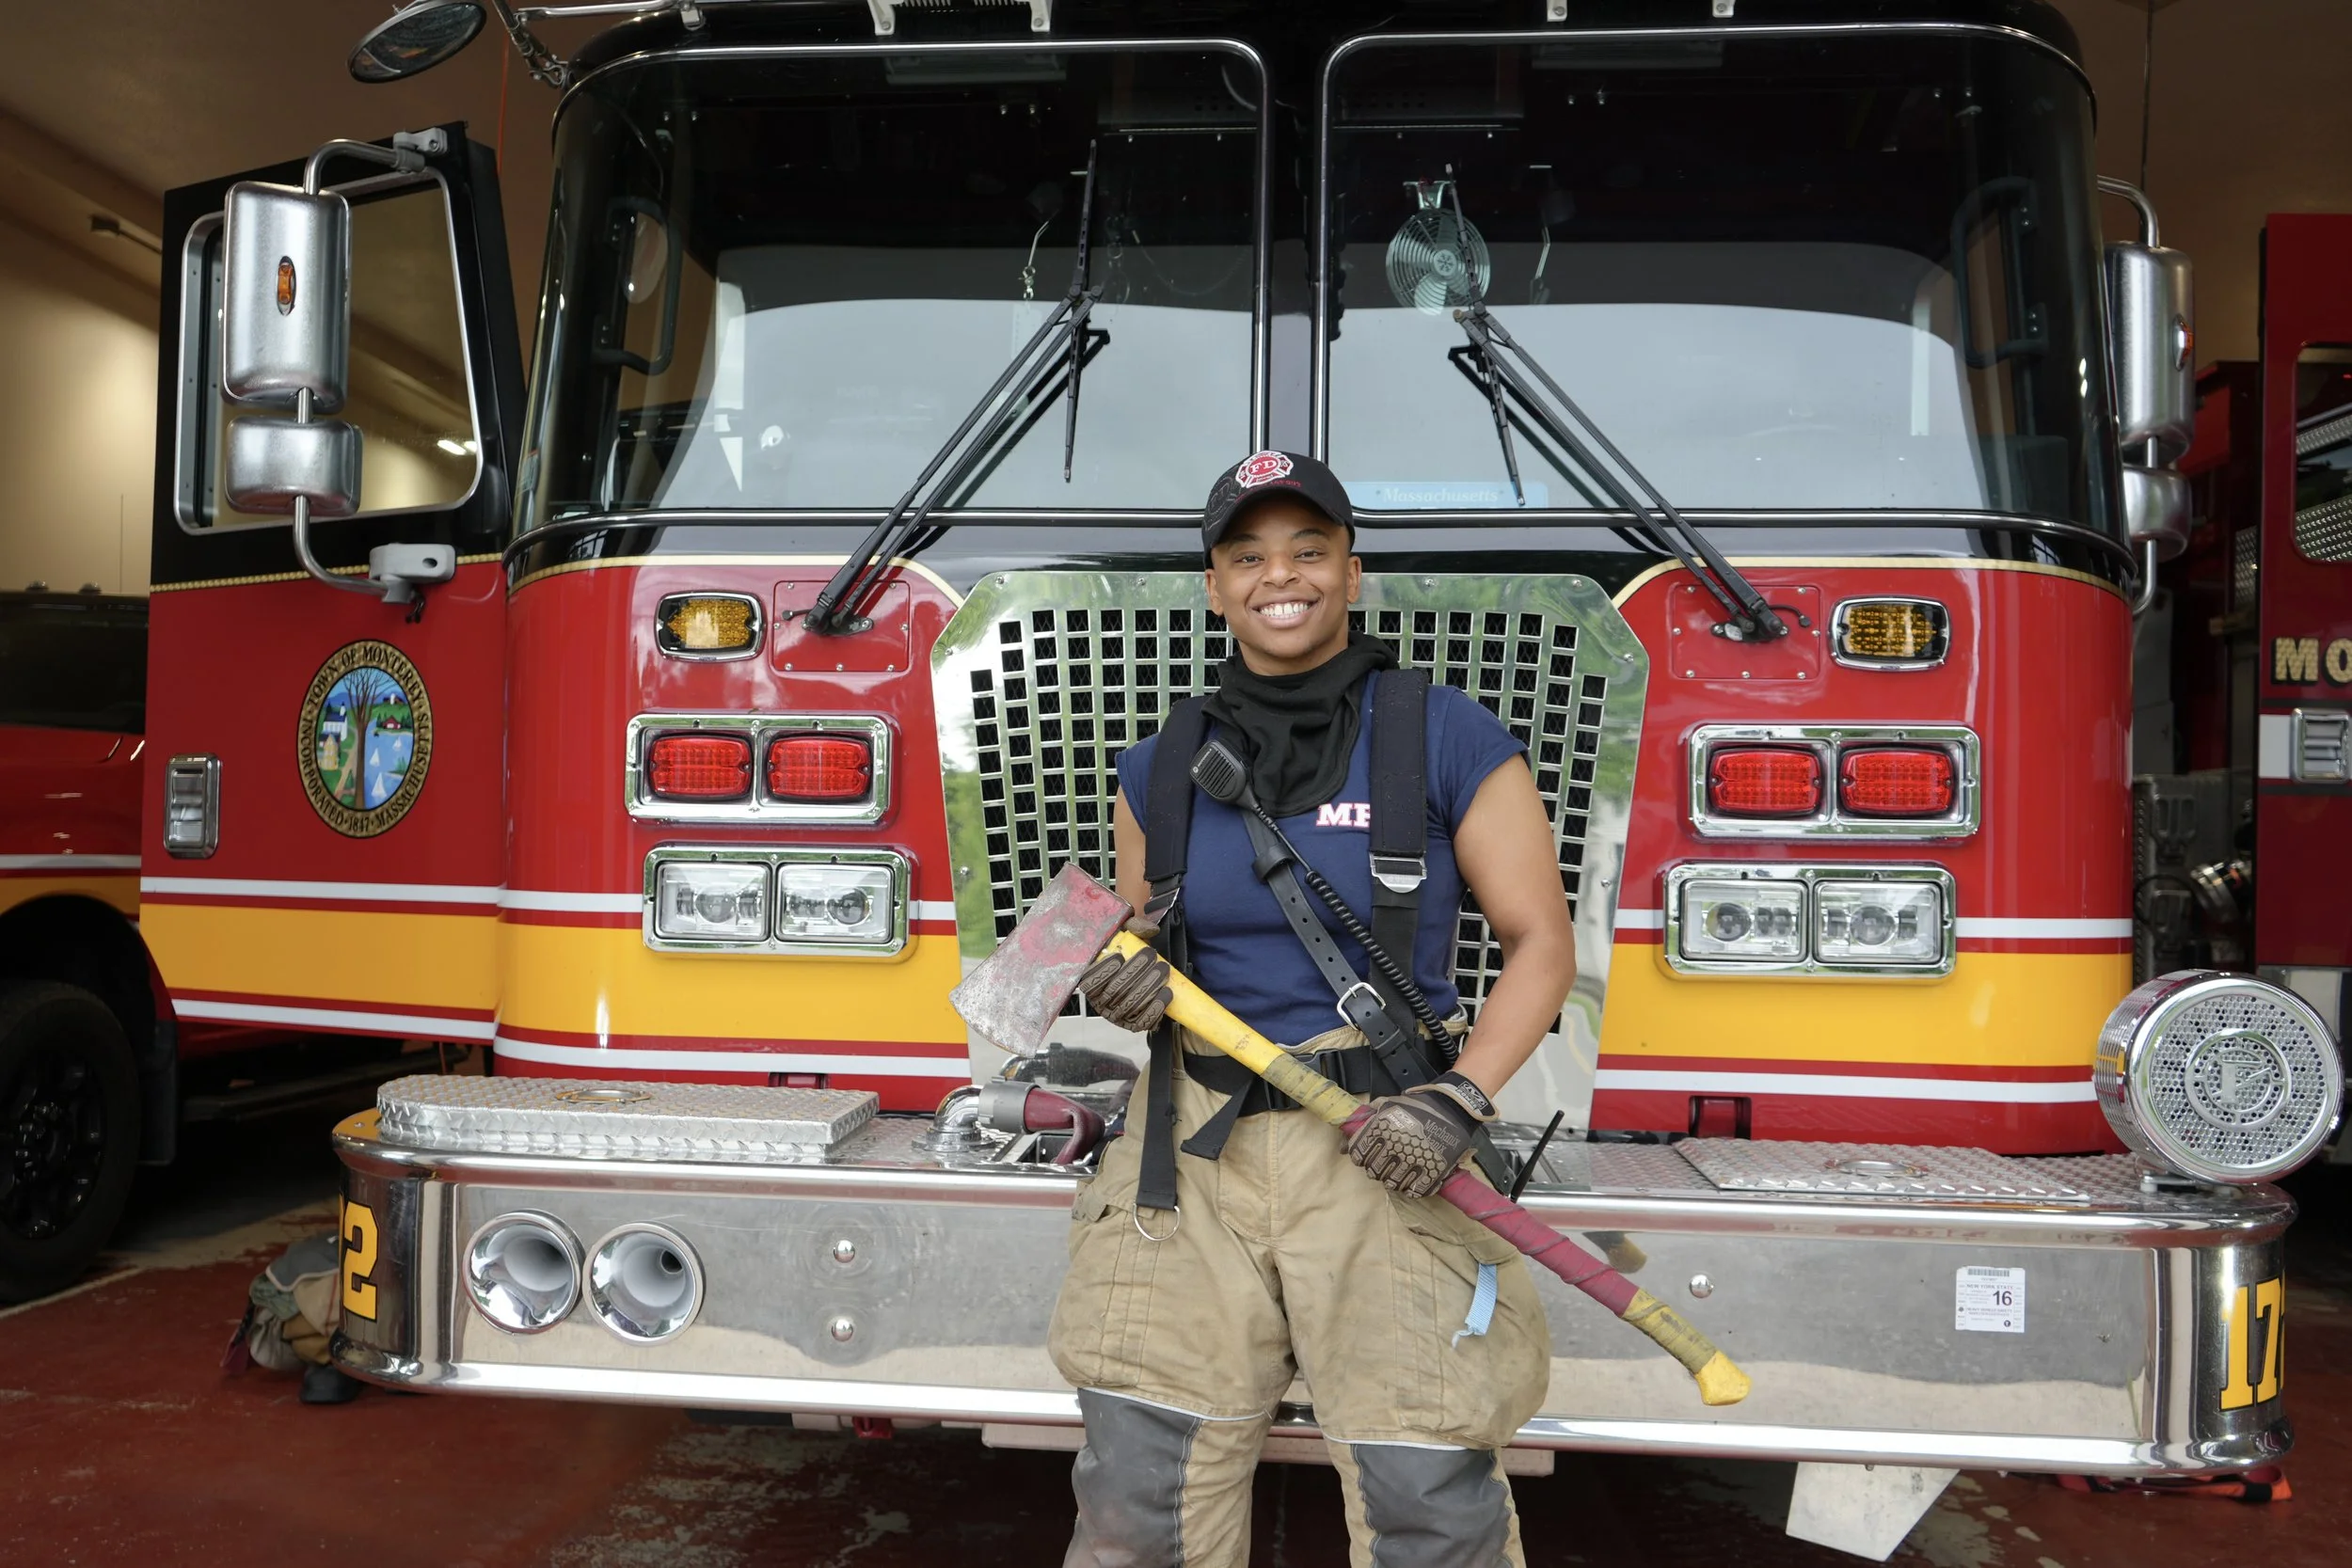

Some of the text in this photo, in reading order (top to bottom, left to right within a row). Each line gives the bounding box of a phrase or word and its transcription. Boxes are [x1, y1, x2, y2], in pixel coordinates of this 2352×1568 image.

[1250, 460, 1278, 474] FD
[1383, 487, 1499, 503] Massachusetts
[307, 645, 424, 707] TOWN OF MONTEREY
[2272, 637, 2352, 685] MO
[300, 712, 430, 832] INCORPORATED 1847 MASSACHUSETTS
[1423, 1118, 1460, 1150] Mechanix
[340, 1193, 378, 1323] 2
[1993, 1291, 2012, 1306] 16
[2218, 1270, 2284, 1411] 17
